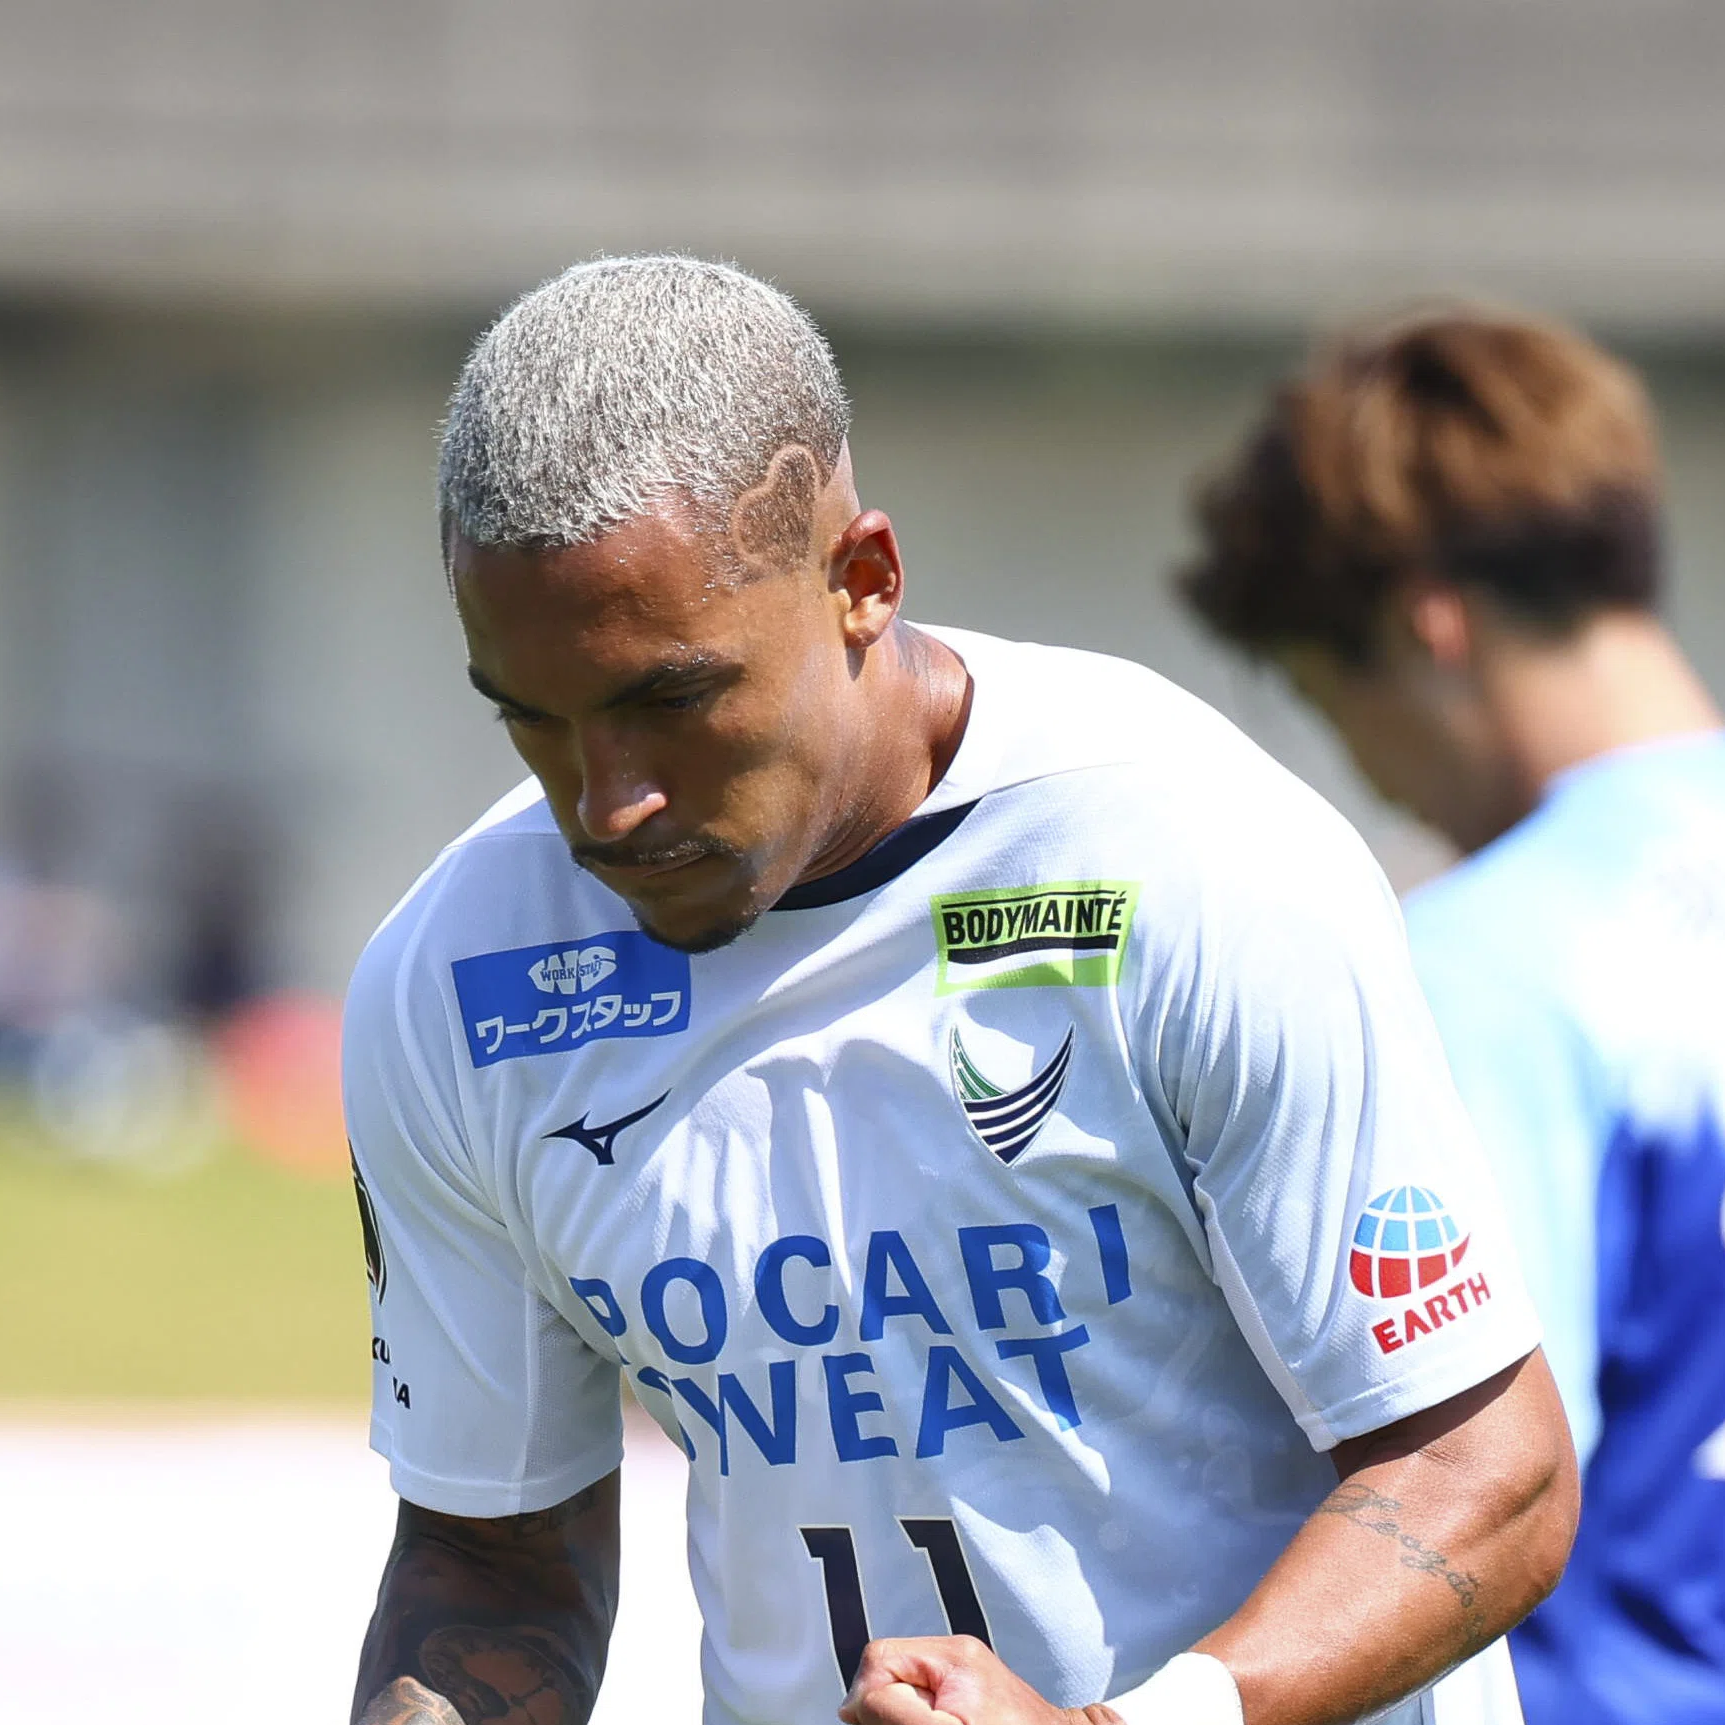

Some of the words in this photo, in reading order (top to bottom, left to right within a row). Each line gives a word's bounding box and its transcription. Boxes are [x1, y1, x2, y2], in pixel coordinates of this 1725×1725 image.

[941, 889, 1127, 946] BODYMAINTÉ
[540, 967, 575, 981] WORK
[476, 991, 681, 1054] ワークスタッフ
[569, 1203, 1132, 1366] POCARI
[1371, 1272, 1491, 1355] EARTH
[799, 1517, 995, 1698] 11
